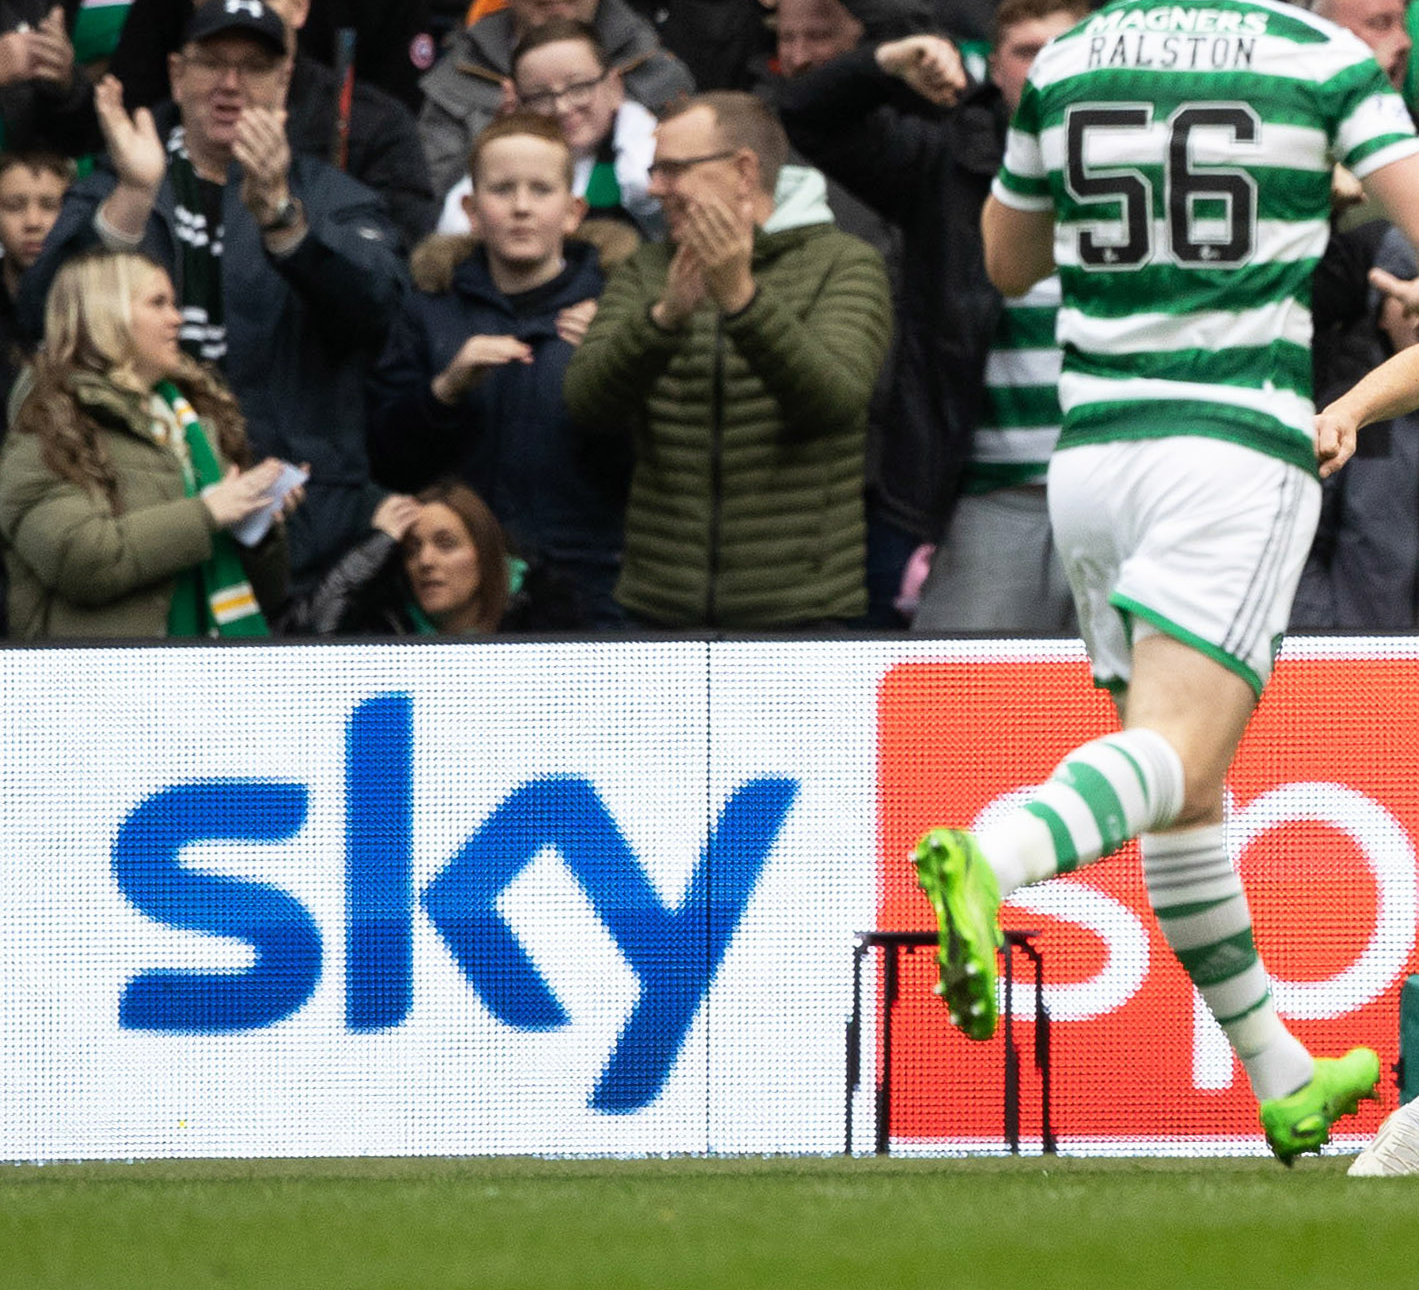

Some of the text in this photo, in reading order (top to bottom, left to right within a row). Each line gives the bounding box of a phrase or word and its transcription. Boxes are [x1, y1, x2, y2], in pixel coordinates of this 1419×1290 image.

[1085, 4, 1269, 35] MAGNERS
[1086, 35, 1257, 69] RALSTON
[1063, 101, 1263, 272] 56
[110, 691, 800, 1114] sky
